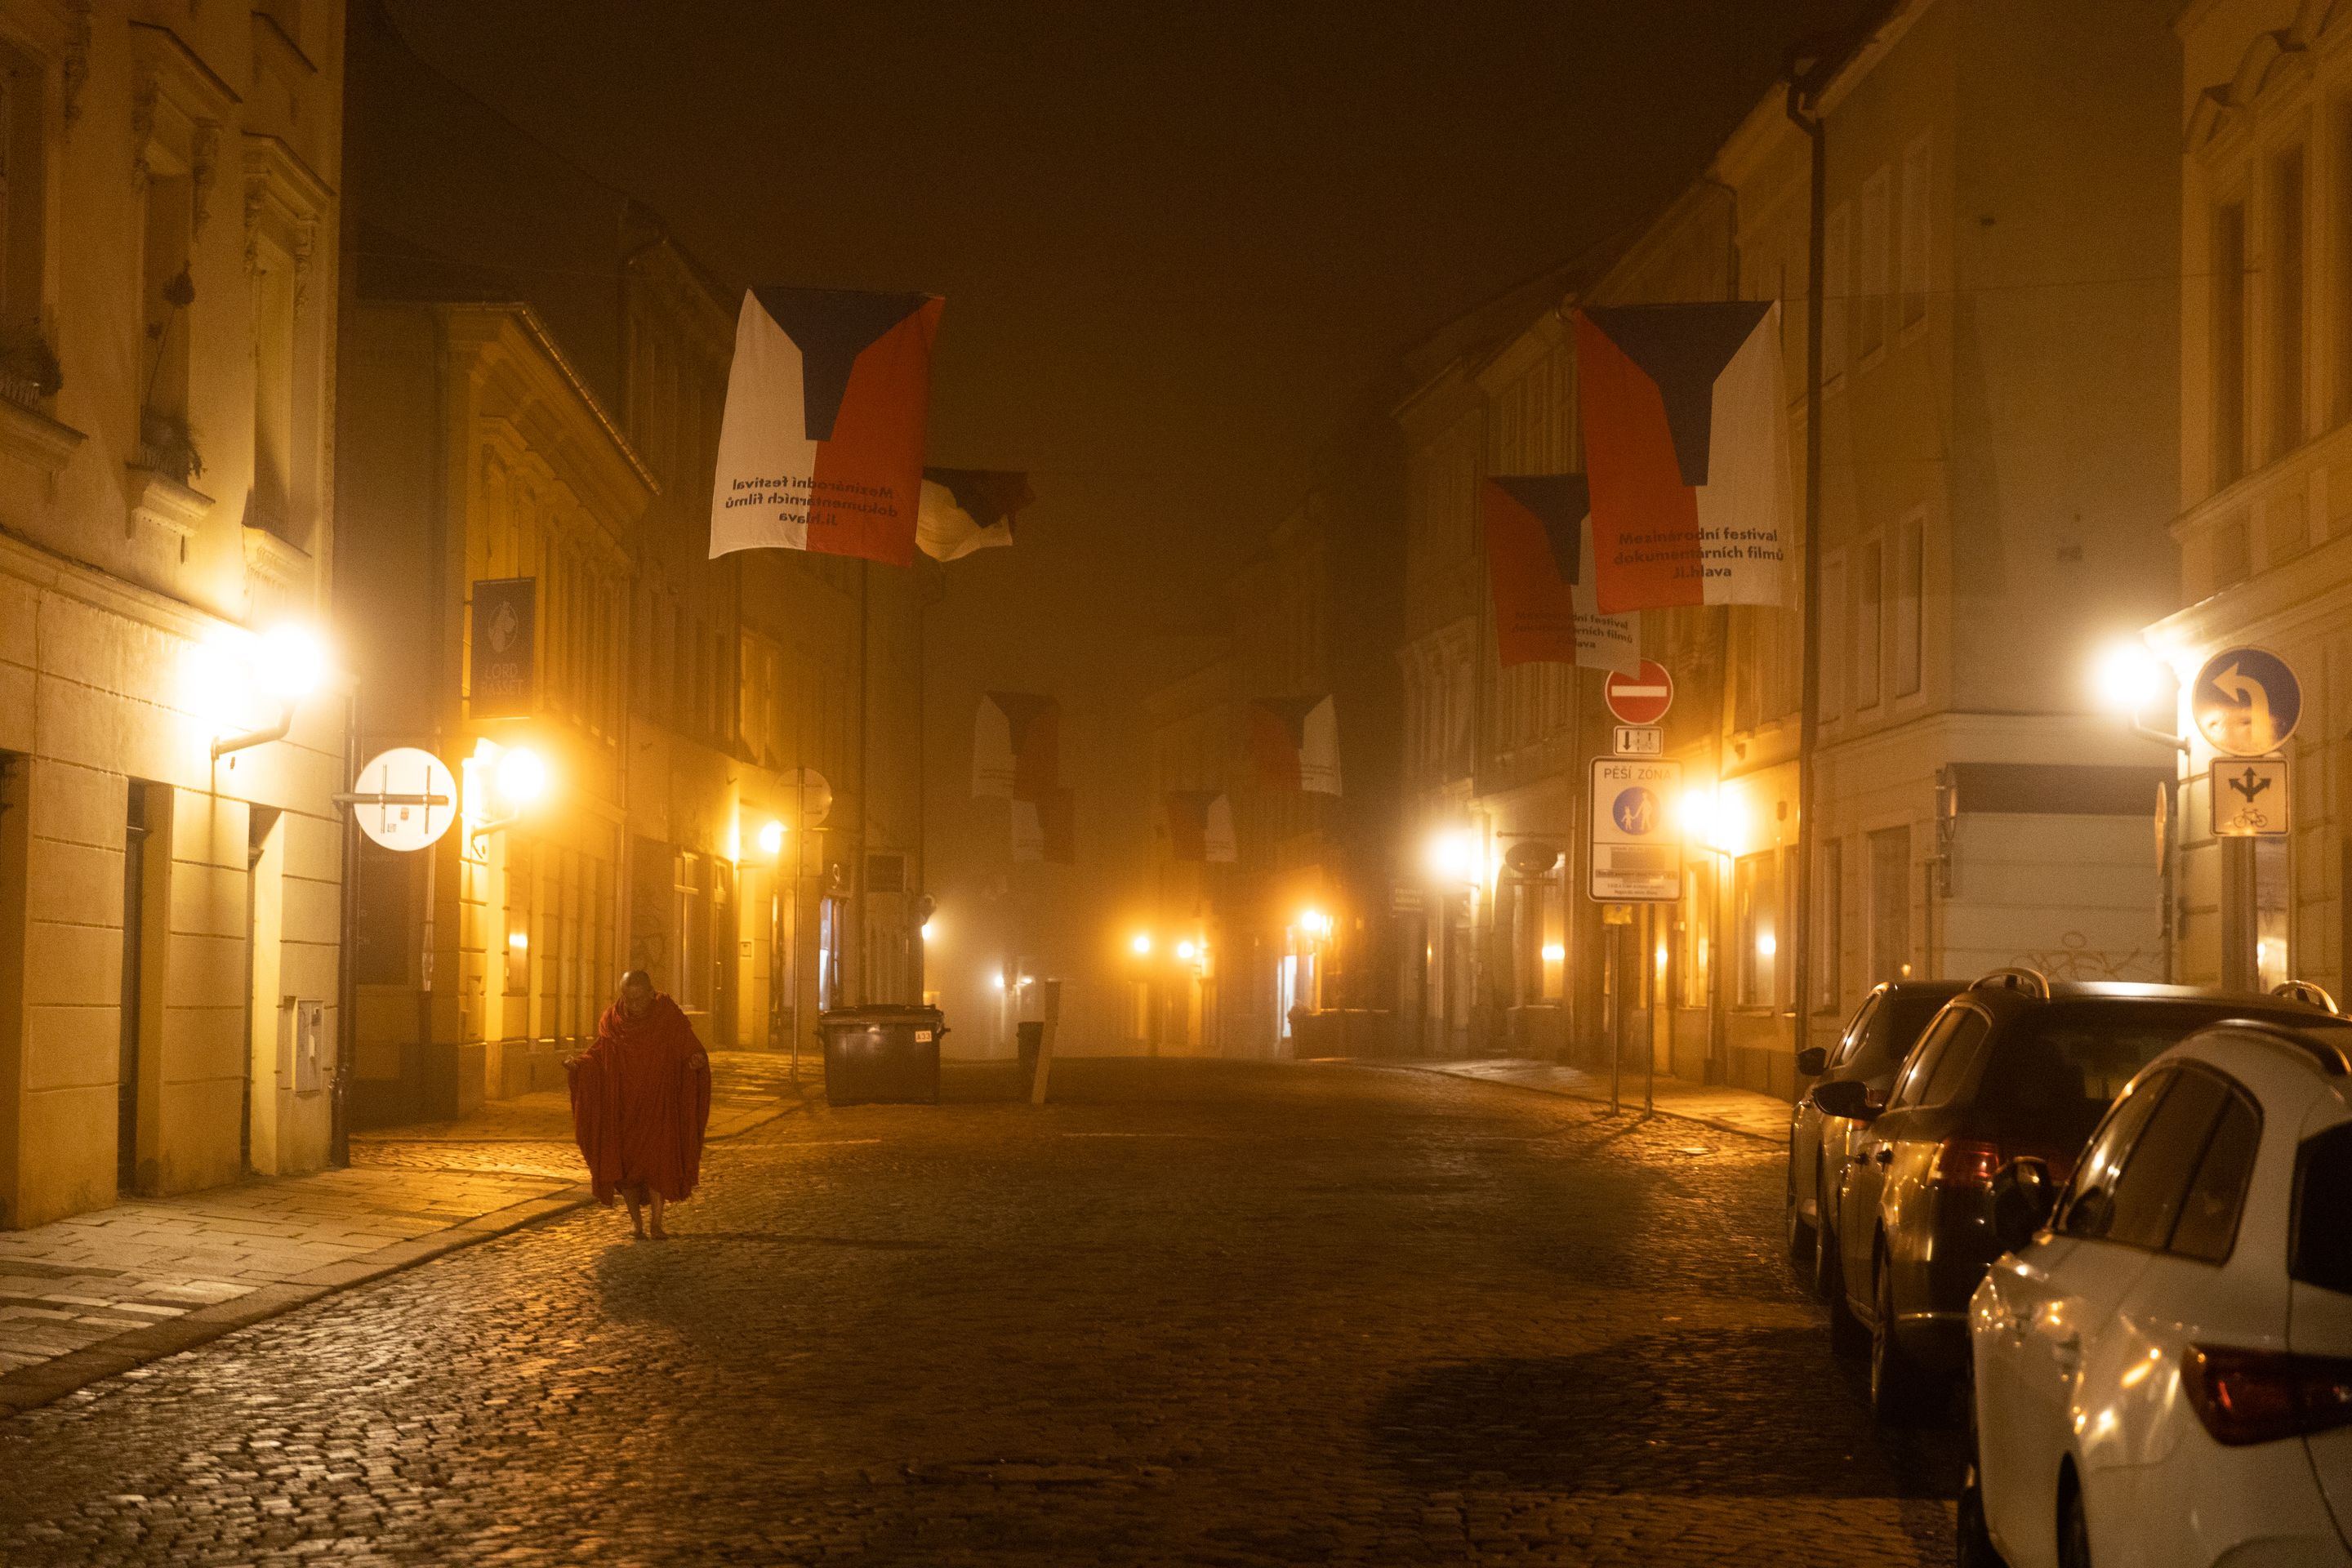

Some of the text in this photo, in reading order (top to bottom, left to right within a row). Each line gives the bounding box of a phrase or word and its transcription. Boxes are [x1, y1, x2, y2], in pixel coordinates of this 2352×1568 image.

[1619, 528, 1778, 546] Mezinárodní festival
[1614, 546, 1784, 565] dokumentárních filmů
[1673, 566, 1732, 578] Ji.hlava
[1590, 614, 1628, 630] festival
[1607, 630, 1633, 644] filmů
[484, 662, 519, 679] LORD
[1604, 765, 1671, 780] PĚŠÍ ZÓNA
